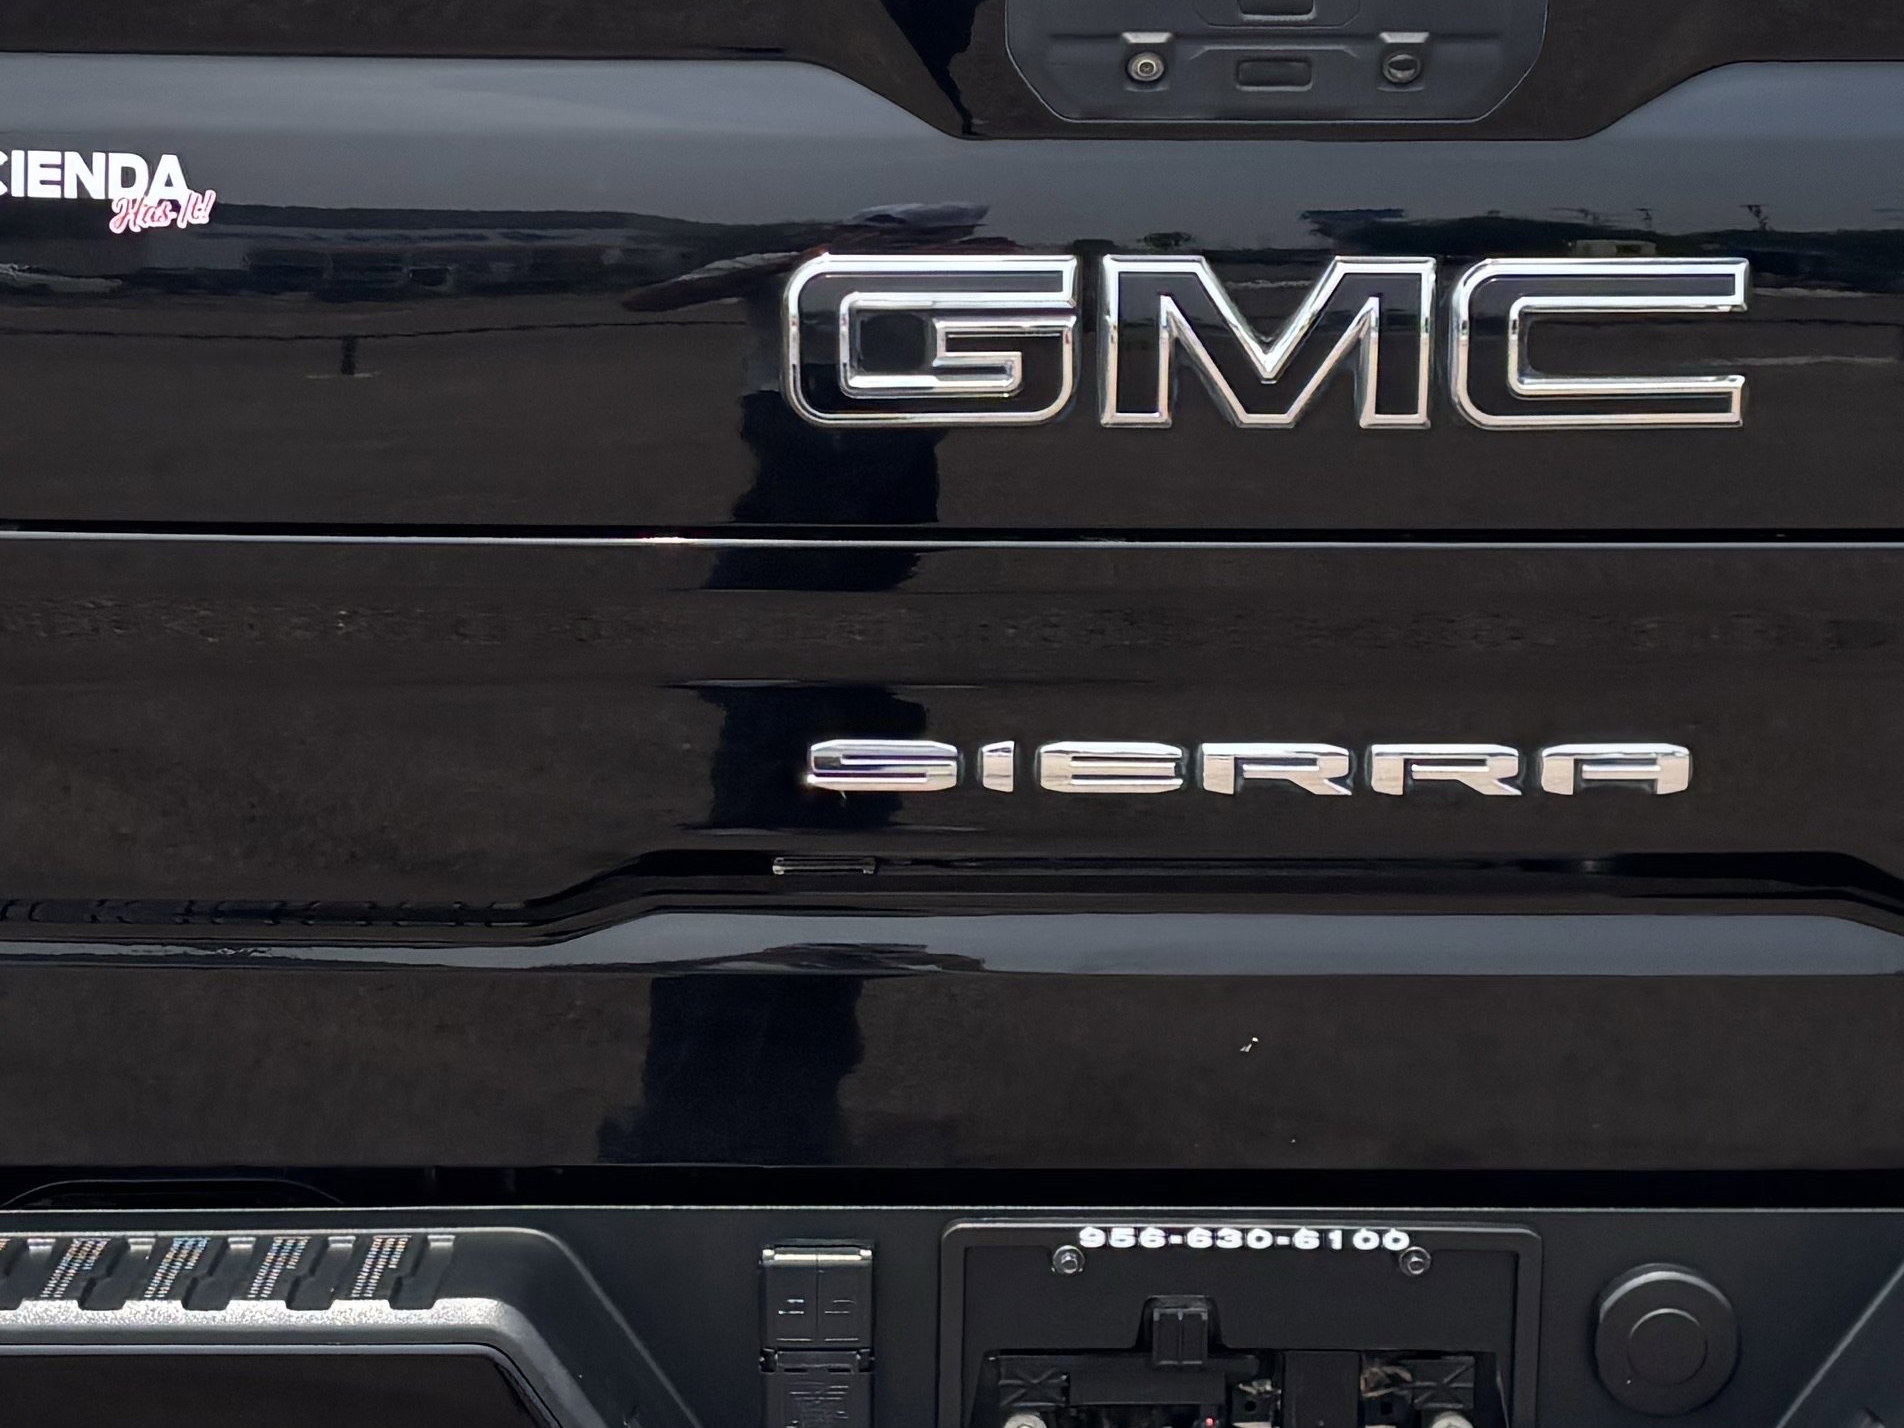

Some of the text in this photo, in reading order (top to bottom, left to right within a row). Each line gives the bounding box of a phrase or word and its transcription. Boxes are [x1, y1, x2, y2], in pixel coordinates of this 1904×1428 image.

[109, 196, 177, 234] Has
[781, 251, 1750, 431] GMC
[807, 738, 1693, 797] SIERRA
[1078, 1226, 1410, 1251] 956-630-6100
